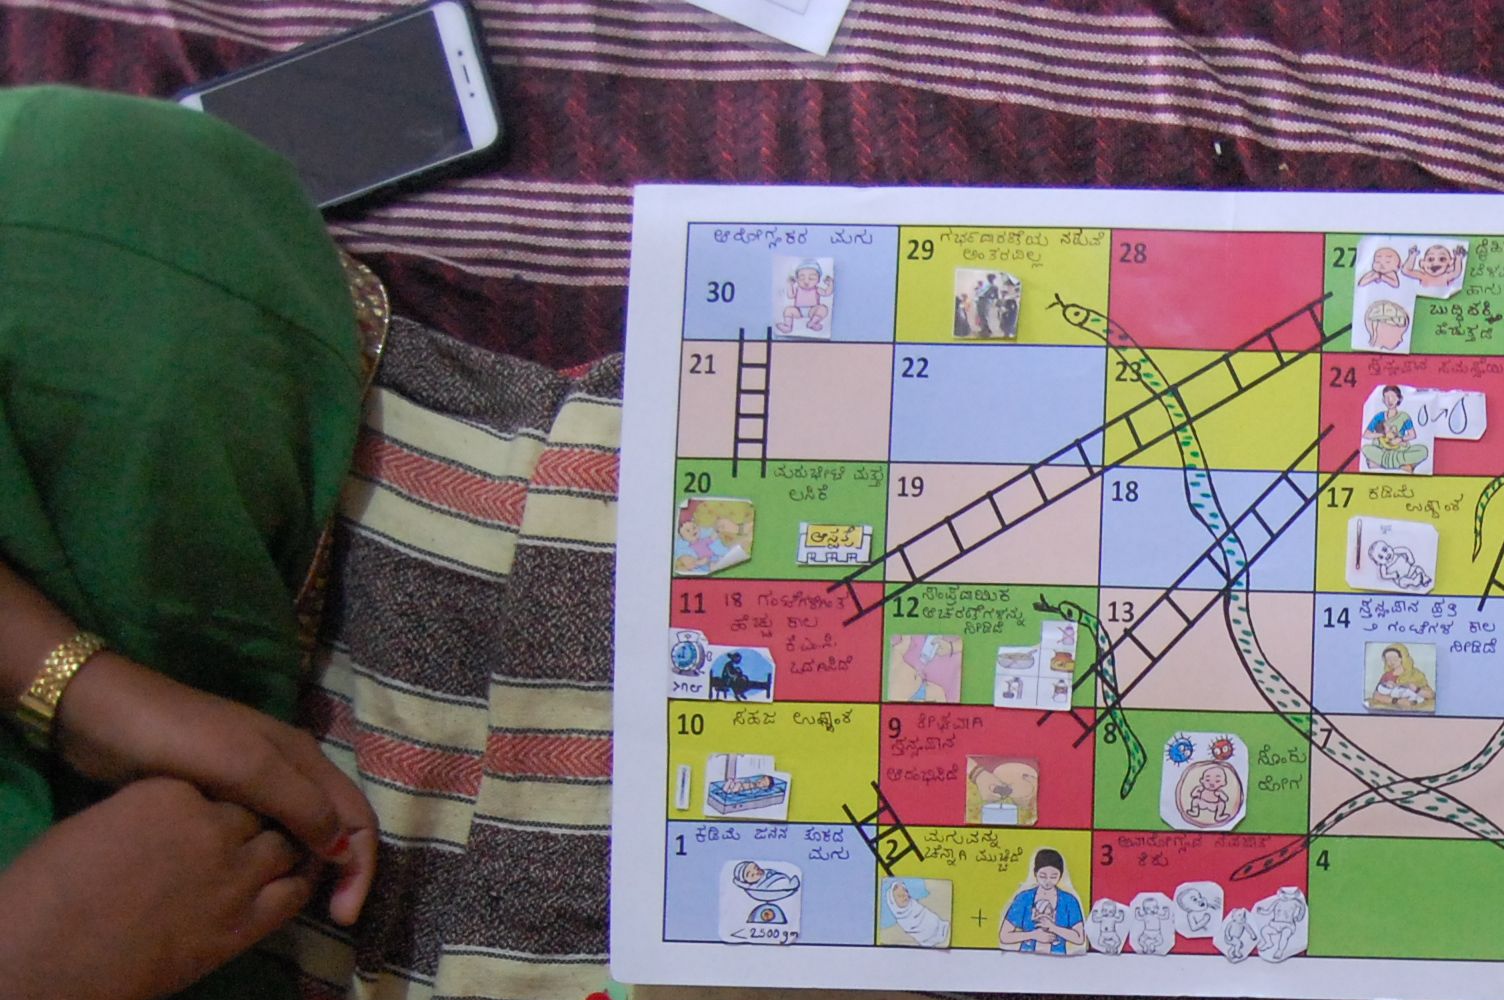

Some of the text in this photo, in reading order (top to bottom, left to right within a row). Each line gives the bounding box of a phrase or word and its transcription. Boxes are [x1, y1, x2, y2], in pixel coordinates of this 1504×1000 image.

[830, 228, 873, 245] ಮಗು
[907, 240, 934, 260] 29
[1120, 243, 1147, 264] 28
[1333, 247, 1357, 268] 27
[706, 281, 735, 302] 30
[690, 354, 716, 374] 21
[901, 357, 929, 378] 22
[1115, 361, 1142, 382] 23
[1330, 367, 1357, 387] 24
[684, 472, 711, 493] 20
[897, 476, 924, 497] 19
[1111, 481, 1139, 502] 18
[1327, 487, 1354, 508] 17
[680, 592, 706, 614] 11
[893, 596, 919, 618] 12
[1108, 601, 1134, 622] 13
[1323, 607, 1350, 628] 14
[677, 713, 704, 735] 10
[888, 717, 901, 739] 9
[1104, 723, 1117, 744] 8
[1320, 728, 1333, 749] 7
[675, 834, 687, 856] 1
[808, 846, 850, 861] ಮಗು
[885, 839, 898, 861] 2
[1100, 844, 1113, 866] 3
[1316, 850, 1330, 871] 4
